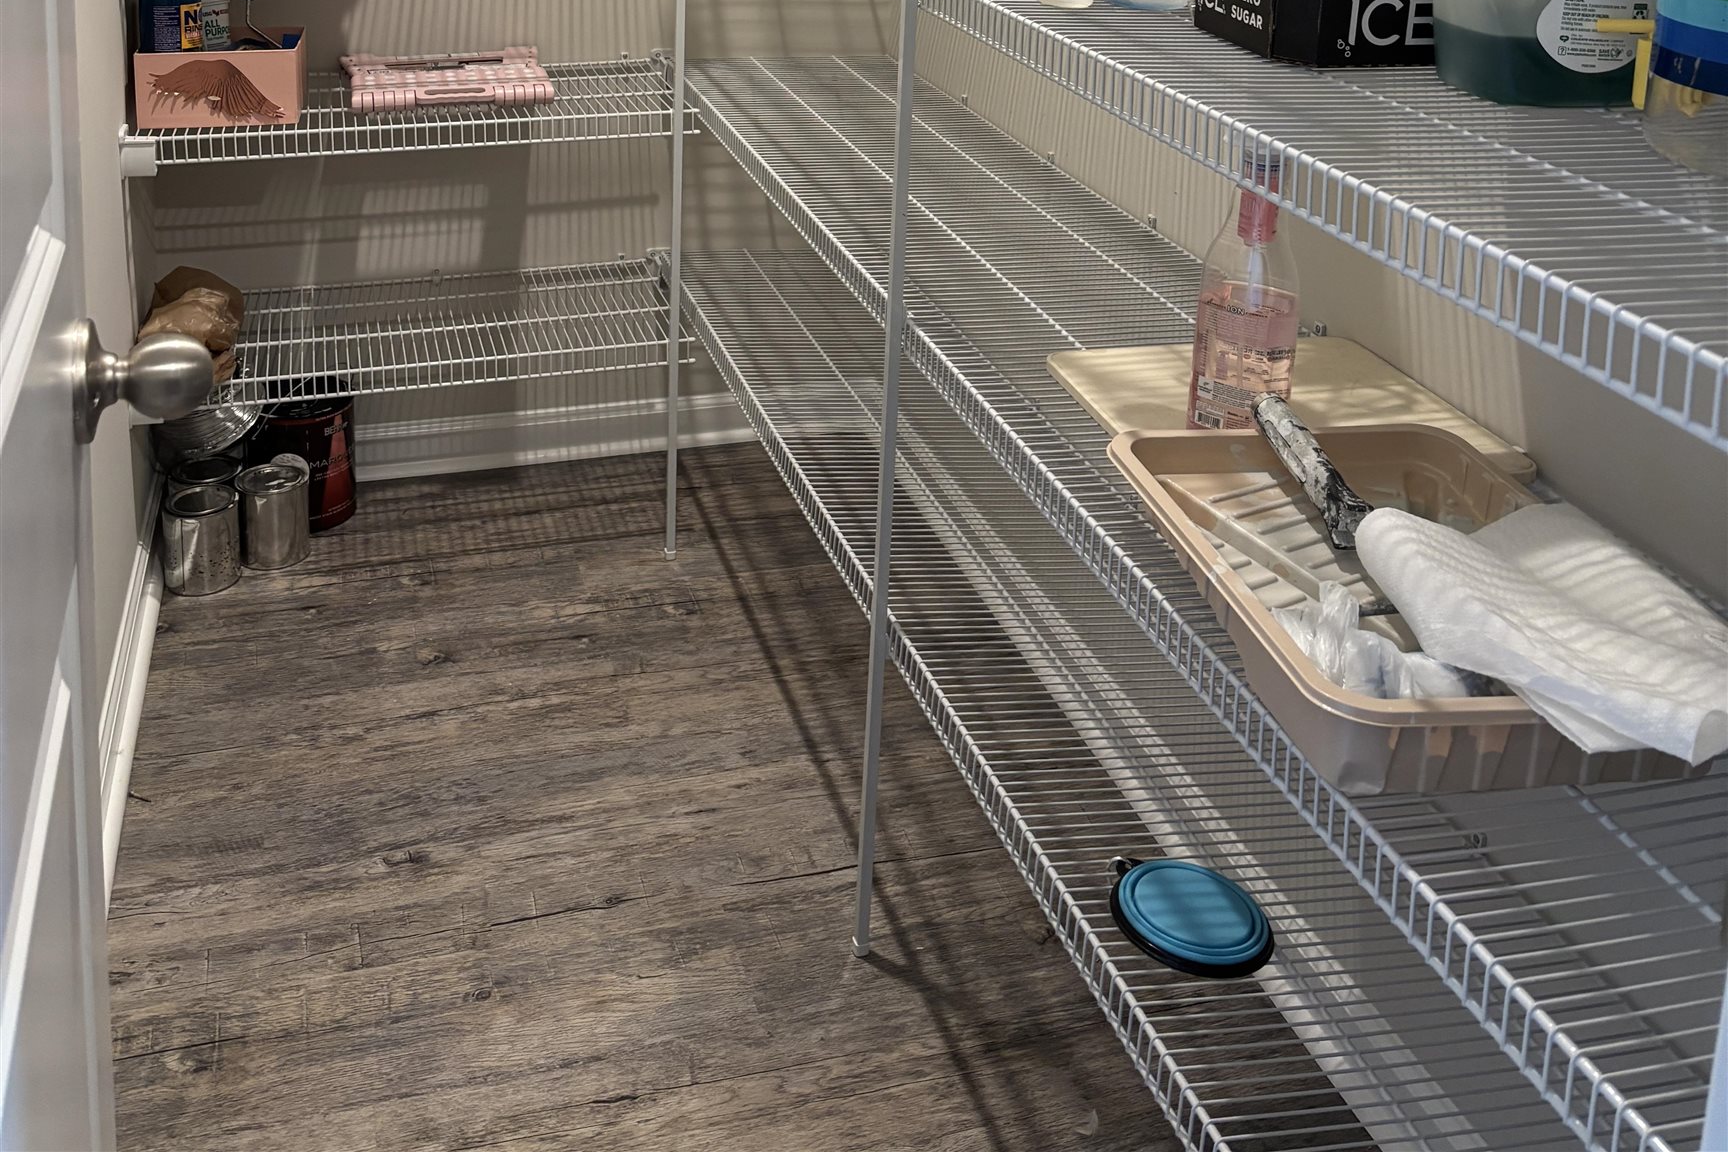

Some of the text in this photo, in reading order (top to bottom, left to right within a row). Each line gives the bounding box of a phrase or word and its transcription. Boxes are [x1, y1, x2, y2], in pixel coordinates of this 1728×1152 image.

[1230, 4, 1263, 30] SUGAR
[185, 23, 203, 33] RINS
[204, 19, 220, 29] ALL
[205, 25, 231, 37] PURPO
